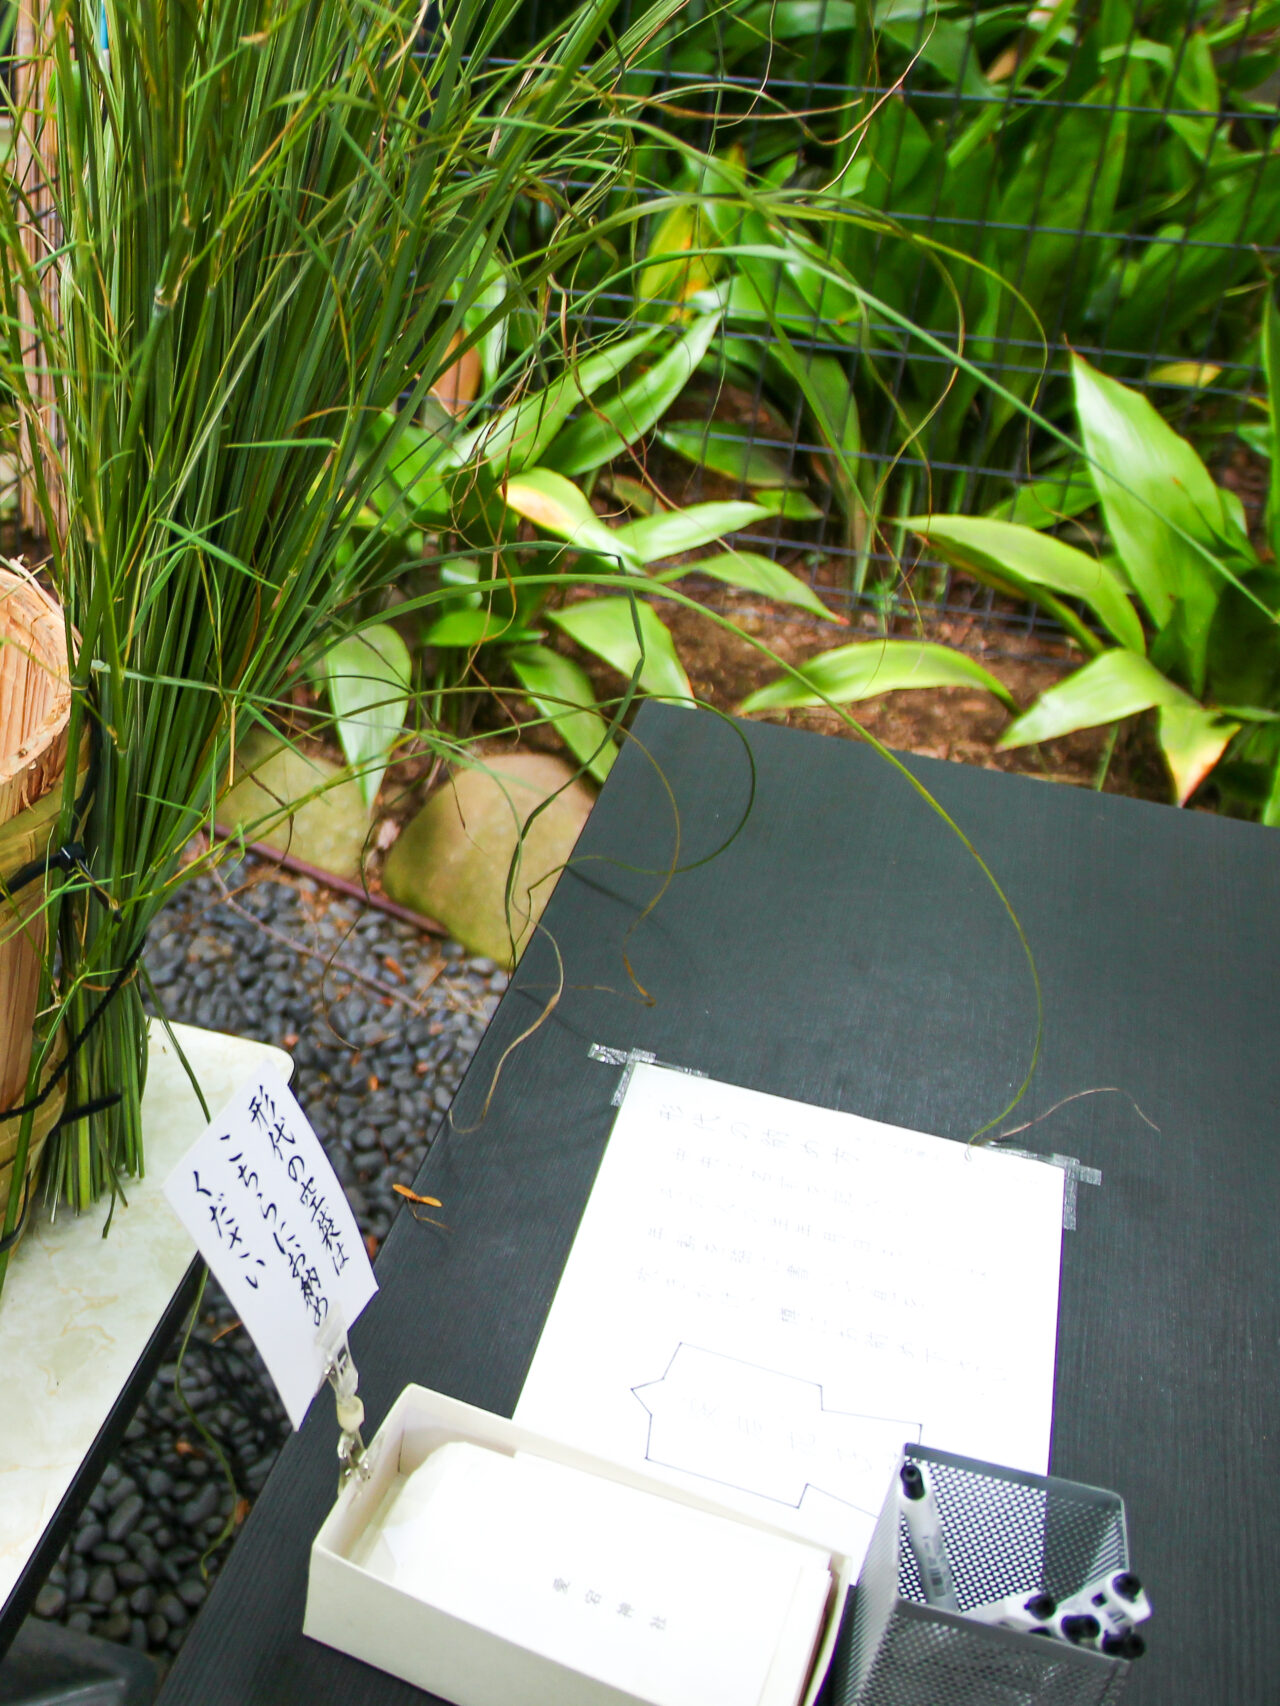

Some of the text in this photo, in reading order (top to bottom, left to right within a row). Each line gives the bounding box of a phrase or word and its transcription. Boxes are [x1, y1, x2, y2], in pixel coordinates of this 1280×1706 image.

[193, 1170, 266, 1289] ください
[220, 1134, 328, 1326] こちらにお納め
